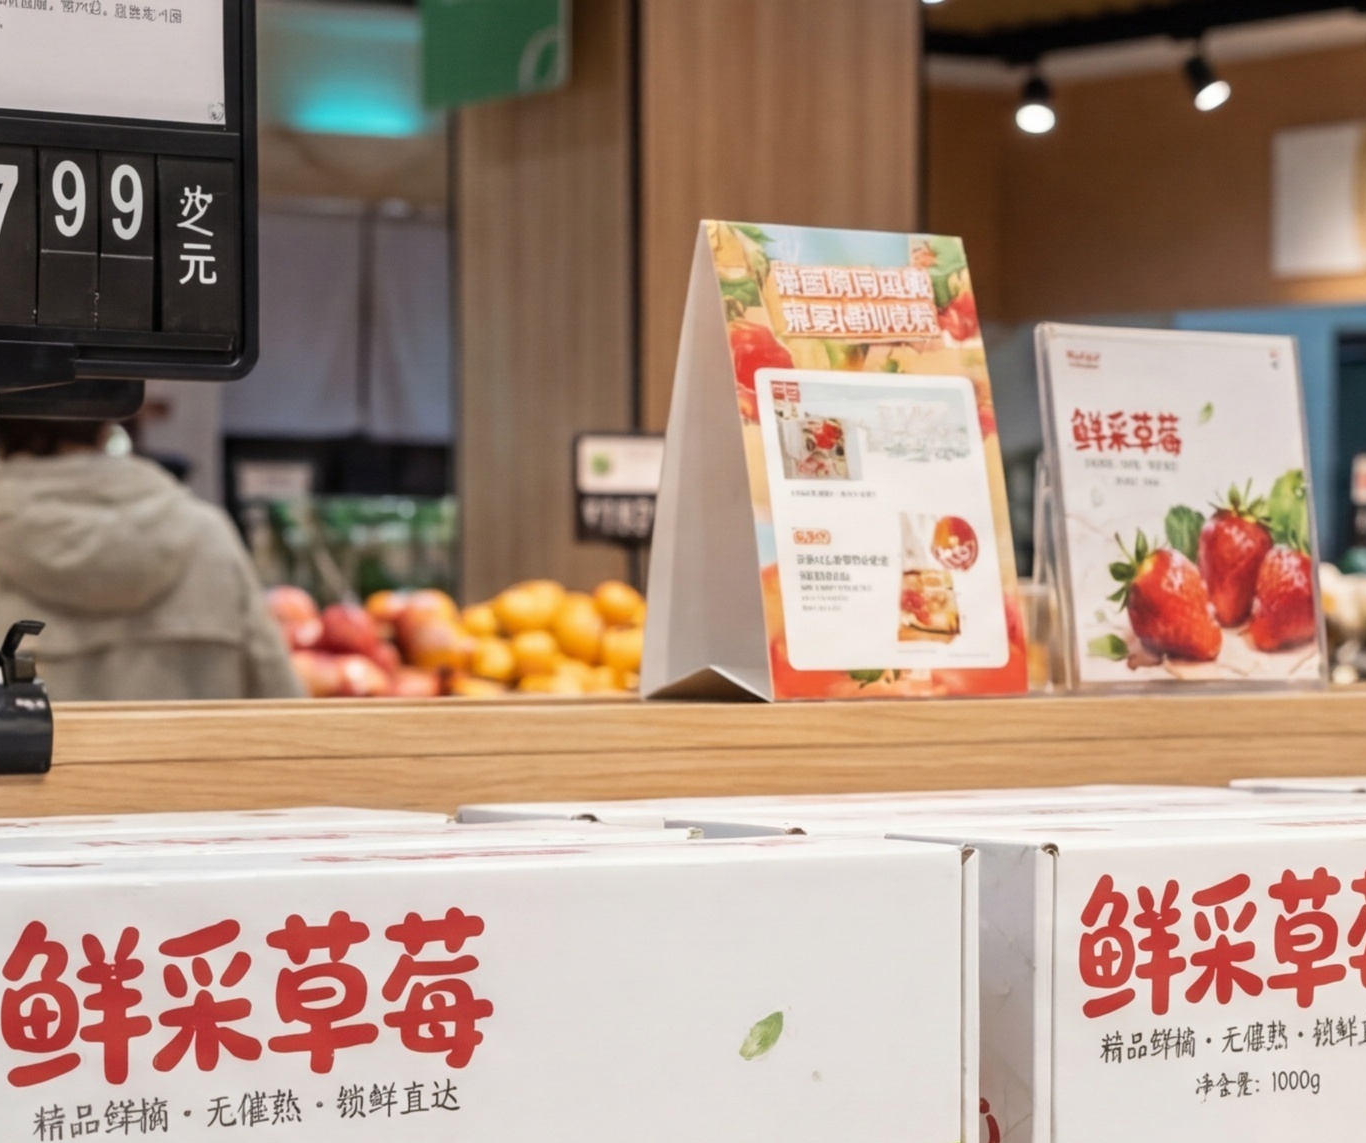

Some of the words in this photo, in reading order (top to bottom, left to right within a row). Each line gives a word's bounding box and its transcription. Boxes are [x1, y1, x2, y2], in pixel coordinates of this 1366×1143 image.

[1071, 408, 1183, 456] 鲜采草莓
[0, 907, 494, 1088] 鲜采草莓
